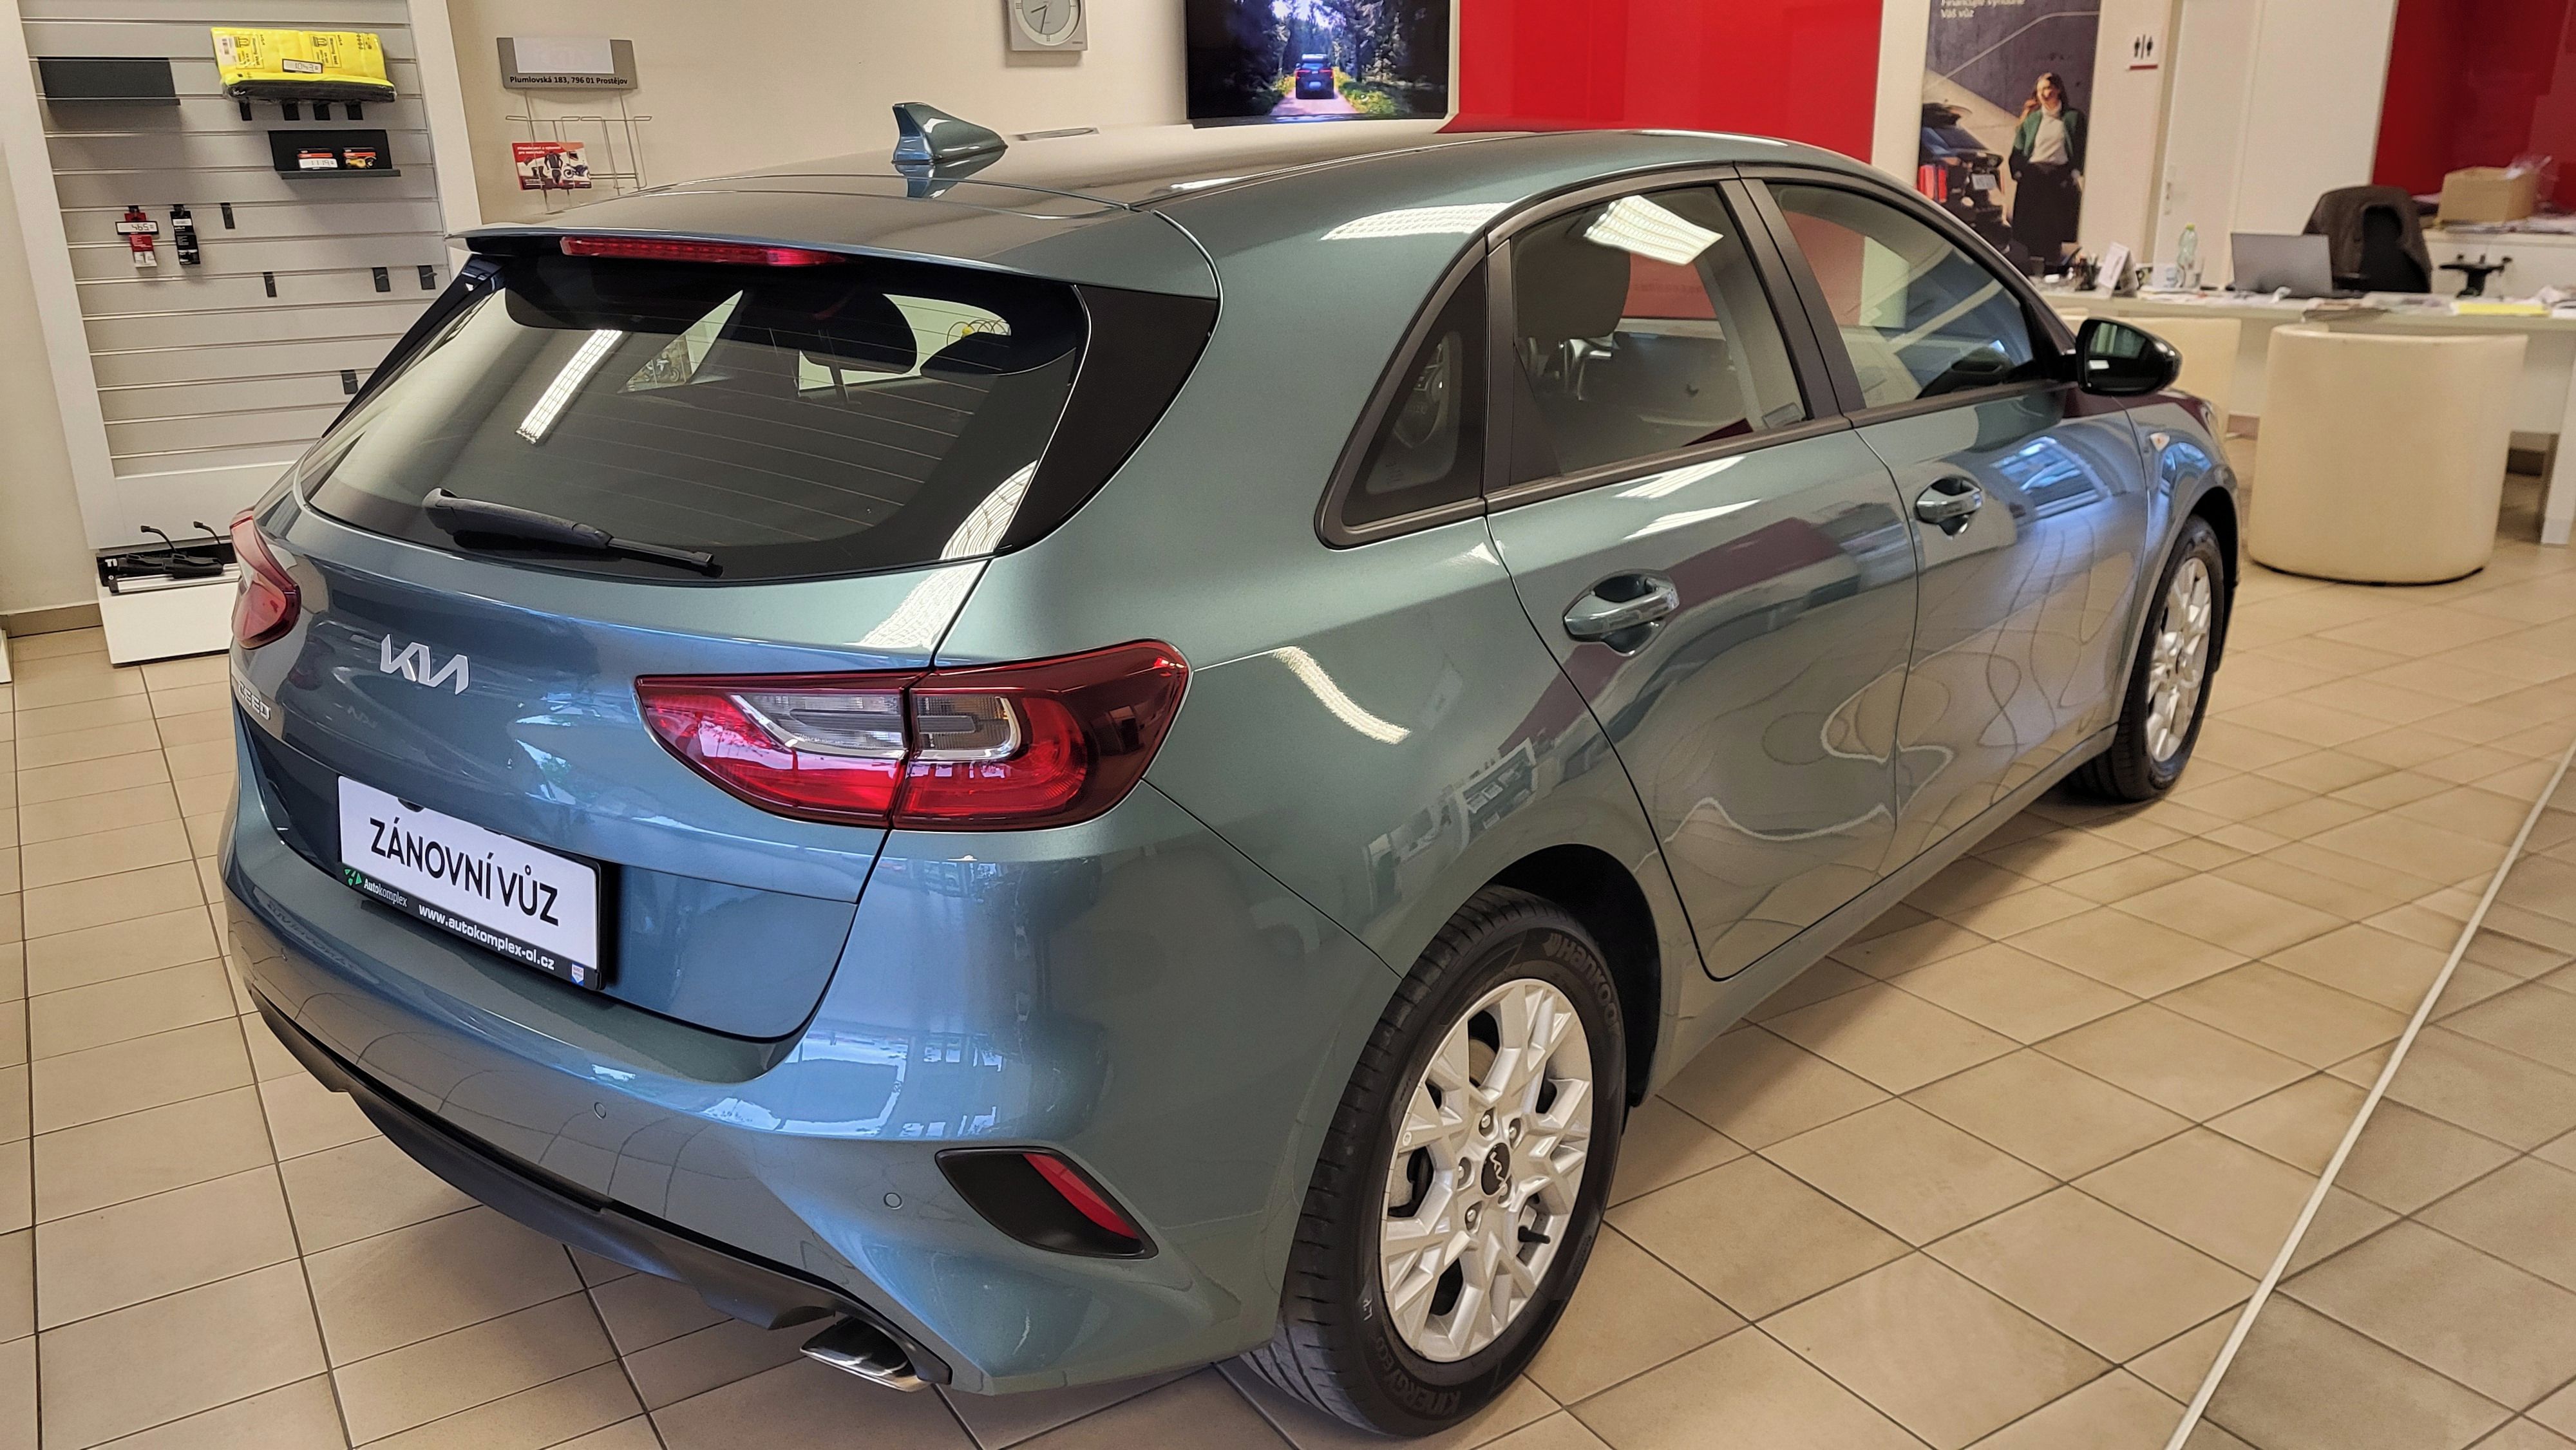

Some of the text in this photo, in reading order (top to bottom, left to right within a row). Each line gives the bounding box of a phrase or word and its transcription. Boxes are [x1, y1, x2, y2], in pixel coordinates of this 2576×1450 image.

[596, 77, 628, 86] Prostějov
[380, 634, 469, 695] KIA
[363, 878, 408, 907] Autokomplex
[370, 816, 559, 927] ZÁNOVNÍ VŮZ
[419, 904, 555, 970] www.autokomplex-ol.cz
